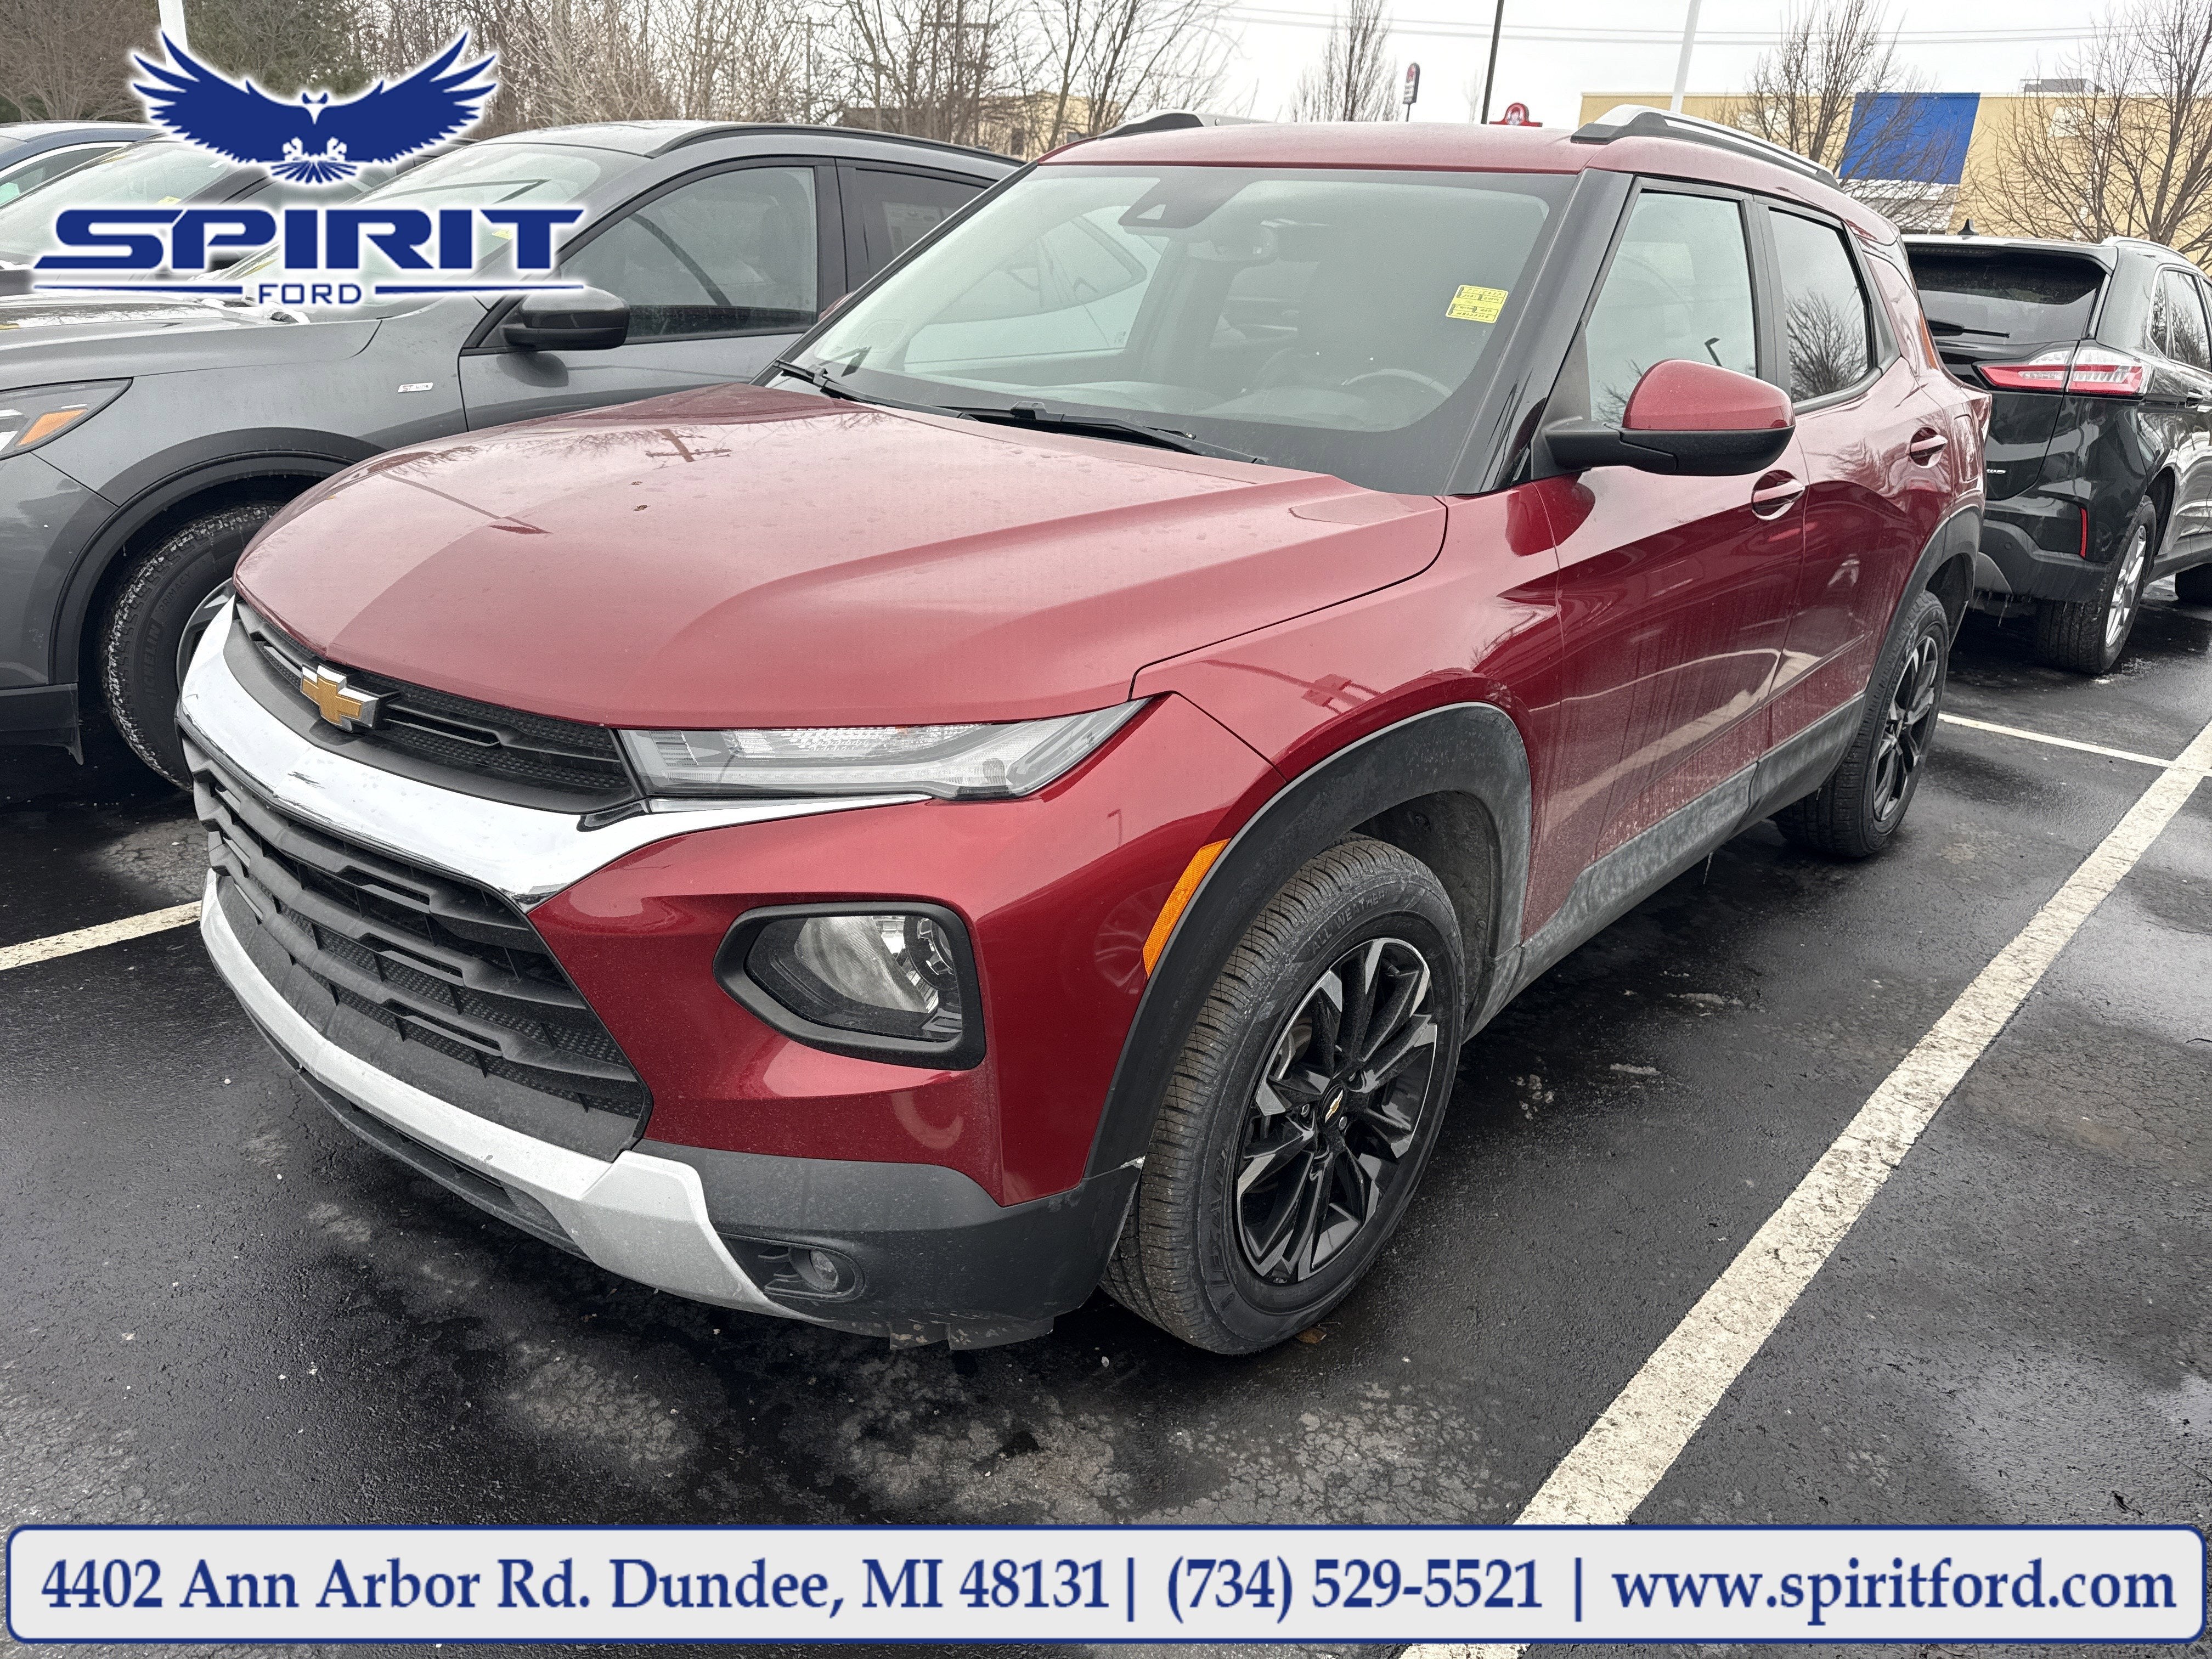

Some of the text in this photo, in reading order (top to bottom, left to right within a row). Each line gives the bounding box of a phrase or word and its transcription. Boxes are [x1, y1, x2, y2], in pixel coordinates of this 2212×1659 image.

[158, 571, 191, 612] PRIMACY
[143, 622, 163, 704] ICHELIN
[1312, 926, 1333, 955] ALL
